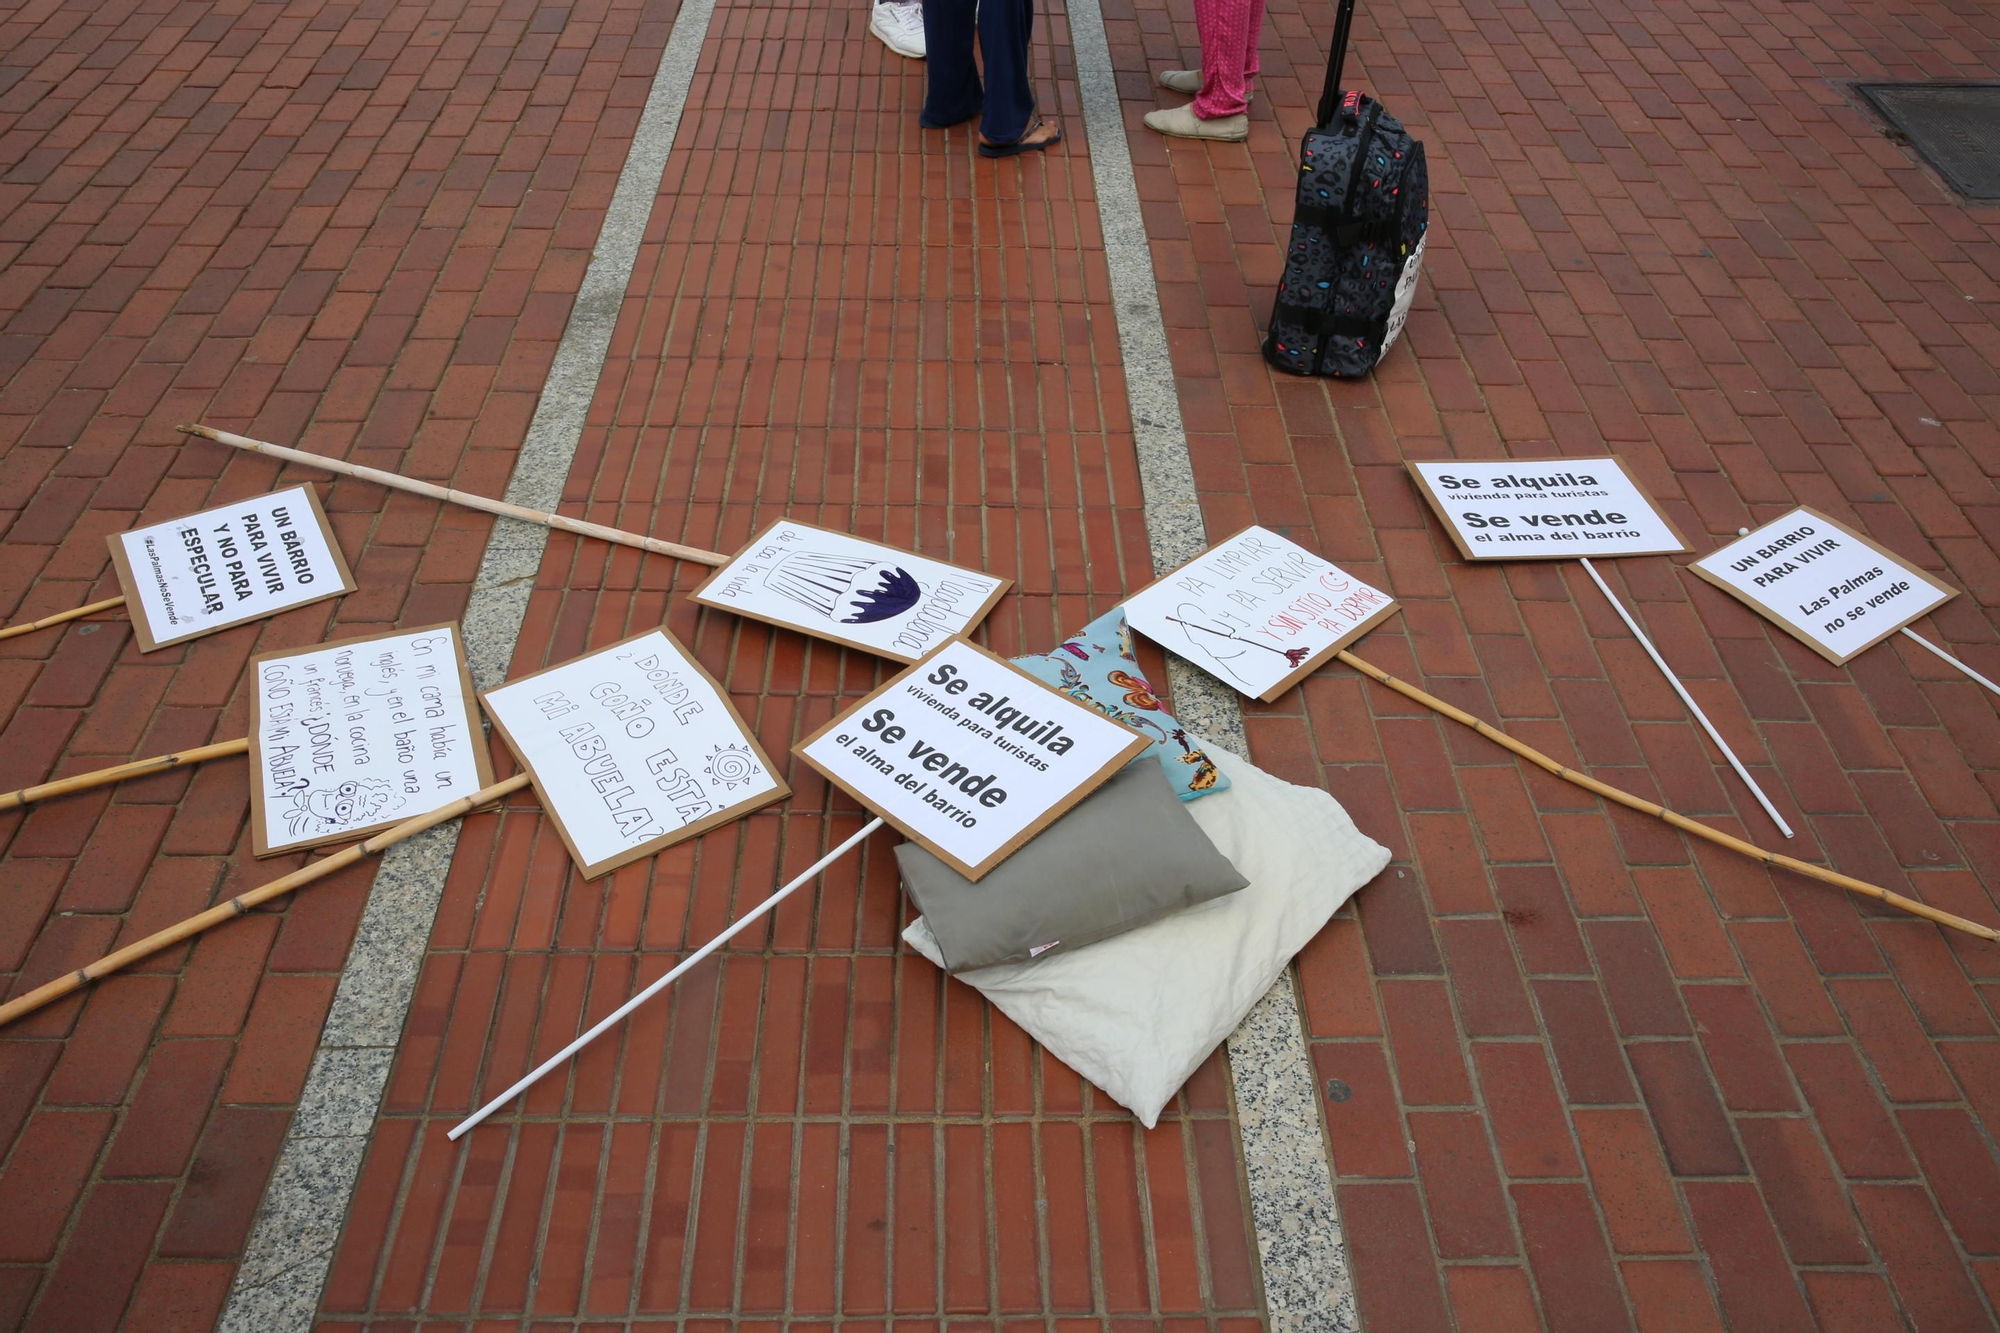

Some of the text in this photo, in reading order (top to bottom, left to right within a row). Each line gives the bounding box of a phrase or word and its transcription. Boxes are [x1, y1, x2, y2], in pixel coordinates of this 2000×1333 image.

[1438, 473, 1599, 491] Se alquila
[1448, 489, 1609, 501] vivienda para turistas
[776, 530, 803, 541] de
[1462, 509, 1628, 528] Se vende
[1474, 529, 1641, 543] el alma del barrio
[213, 523, 253, 602] Y NO PARA
[241, 513, 285, 595] PARA VIVIR
[271, 506, 315, 585] UN BARRIO
[742, 563, 769, 574] la
[1176, 537, 1281, 597] PA LIMPIAR
[1730, 526, 1816, 573] UN BARRIO
[1753, 538, 1841, 588] PARA VIVIR
[144, 537, 179, 626] #LasPalmasNoSeVende
[181, 527, 224, 616] ESPECULAR
[718, 576, 753, 598] vida
[1227, 589, 1266, 611] PA
[1252, 551, 1324, 595] SERVIR
[1799, 565, 1884, 616] Las Palmas
[1317, 587, 1389, 635] PA DORMIR
[1824, 579, 1910, 634] no se vende
[263, 664, 294, 700] COÑO
[303, 663, 318, 676] un
[343, 695, 360, 709] en
[344, 709, 370, 722] la
[364, 650, 421, 794] inglés, y en el baño una
[411, 636, 457, 790] En mi cama había un
[589, 681, 655, 739] COÑO
[927, 663, 1075, 757] Se alquila
[349, 726, 371, 765] cocina
[906, 684, 1050, 773] vivienda para turistas
[835, 732, 977, 829] el alma del barrio
[861, 708, 1008, 809] Se vende
